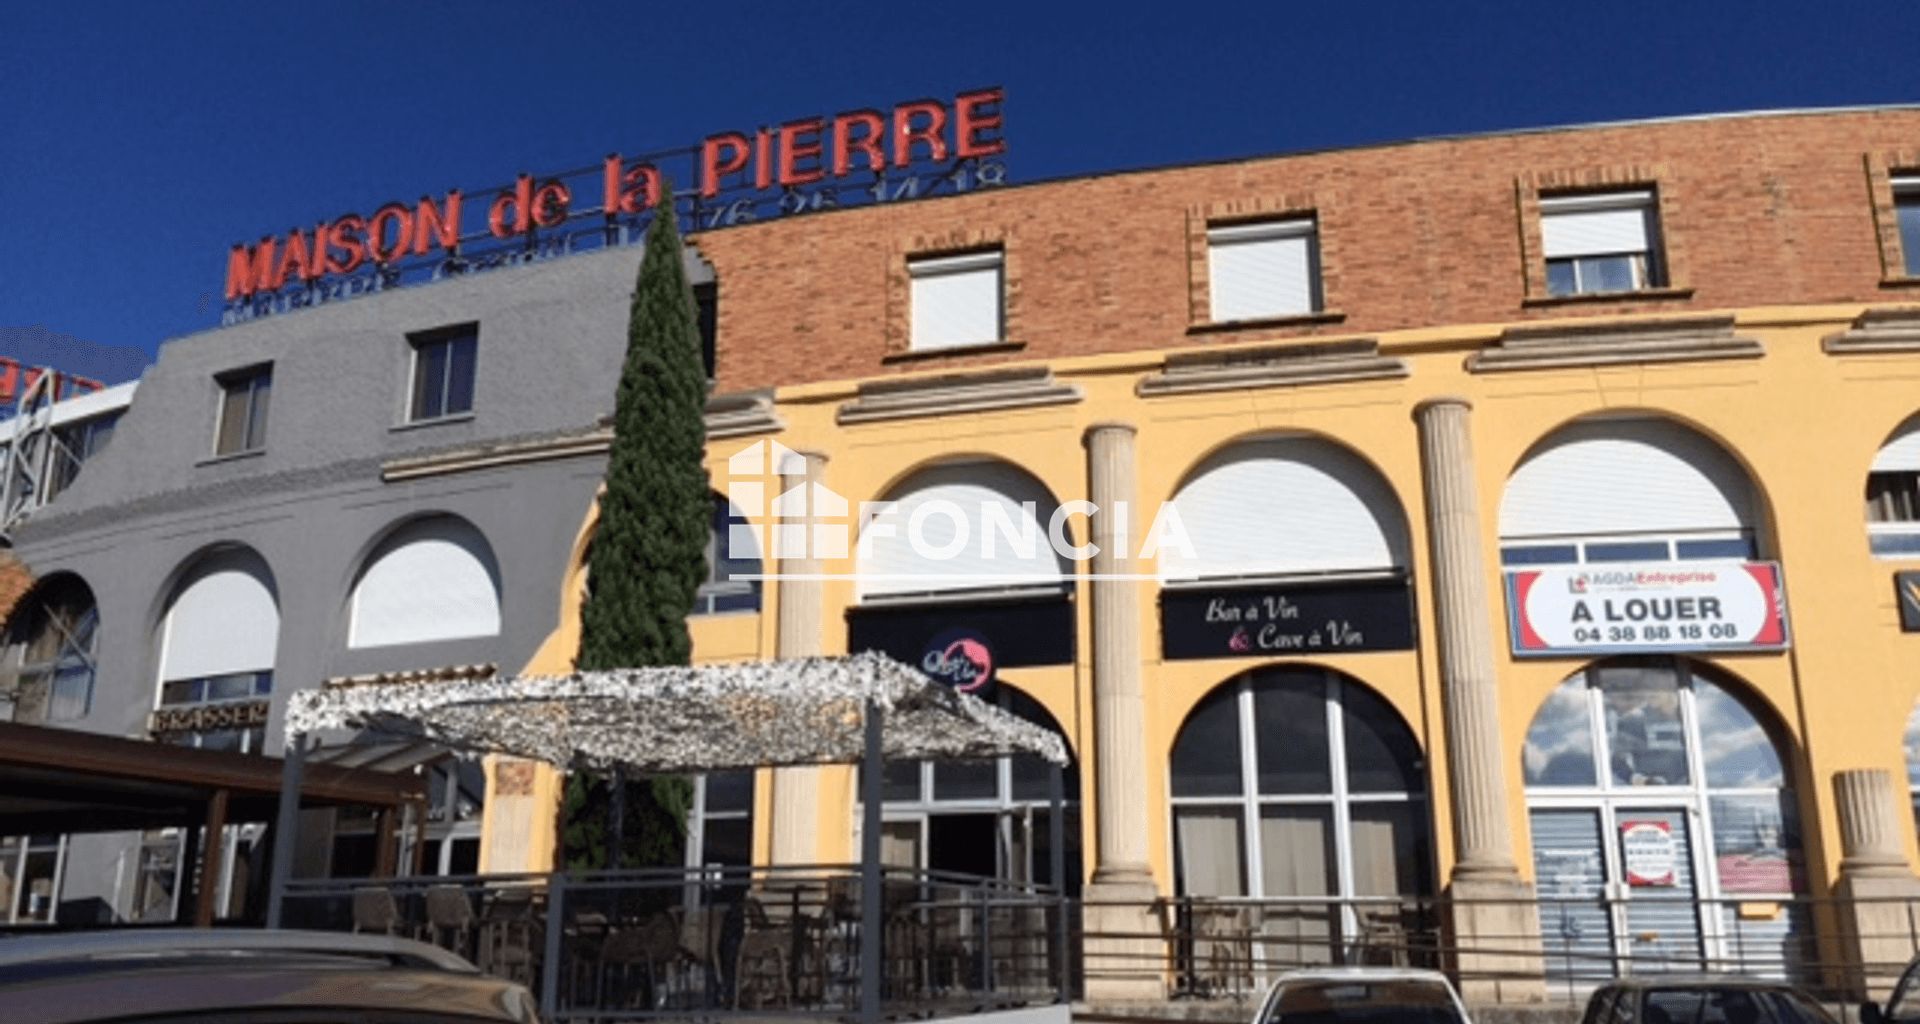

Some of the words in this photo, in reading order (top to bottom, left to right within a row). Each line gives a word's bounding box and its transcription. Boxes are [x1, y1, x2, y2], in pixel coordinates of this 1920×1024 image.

[225, 189, 463, 301] MAISON
[489, 173, 571, 239] de
[604, 152, 662, 215] la
[702, 85, 1004, 198] PIERRE
[1206, 598, 1241, 622] Bar
[1263, 595, 1299, 620] Vin
[1571, 599, 1593, 623] A
[1604, 596, 1723, 621] LOUER
[1257, 622, 1304, 648] Cave
[1326, 619, 1364, 646] Vin
[1573, 626, 1602, 643] 04
[1608, 625, 1637, 642] 38
[1643, 624, 1671, 641] 88
[1679, 623, 1701, 640] 18
[1708, 622, 1738, 639] 08
